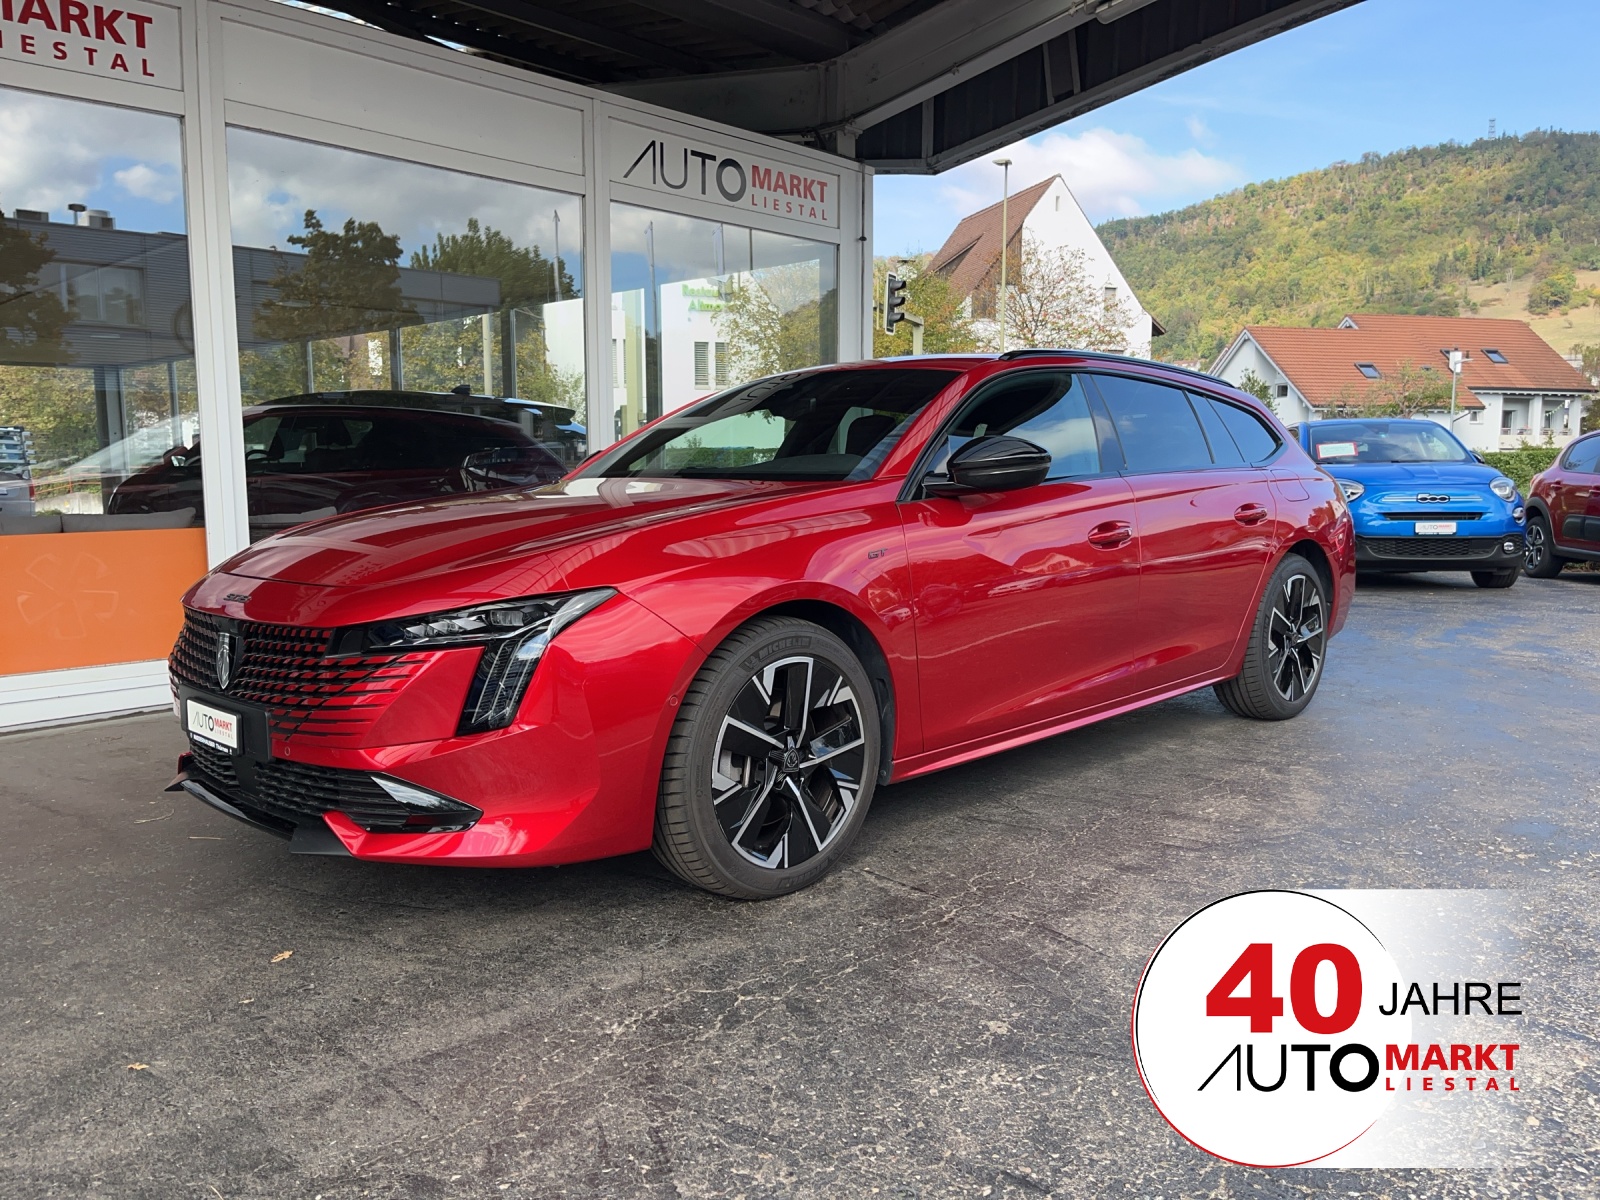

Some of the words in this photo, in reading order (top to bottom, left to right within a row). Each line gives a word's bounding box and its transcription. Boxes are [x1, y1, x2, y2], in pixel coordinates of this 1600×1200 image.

[623, 139, 747, 203] AUTO
[751, 164, 828, 203] MARKT
[751, 193, 828, 221] LIESTAL
[1417, 493, 1449, 503] 500
[868, 548, 888, 559] GT
[758, 636, 810, 659] MICHELIN
[193, 711, 214, 731] AUTO
[214, 717, 232, 732] MARKT
